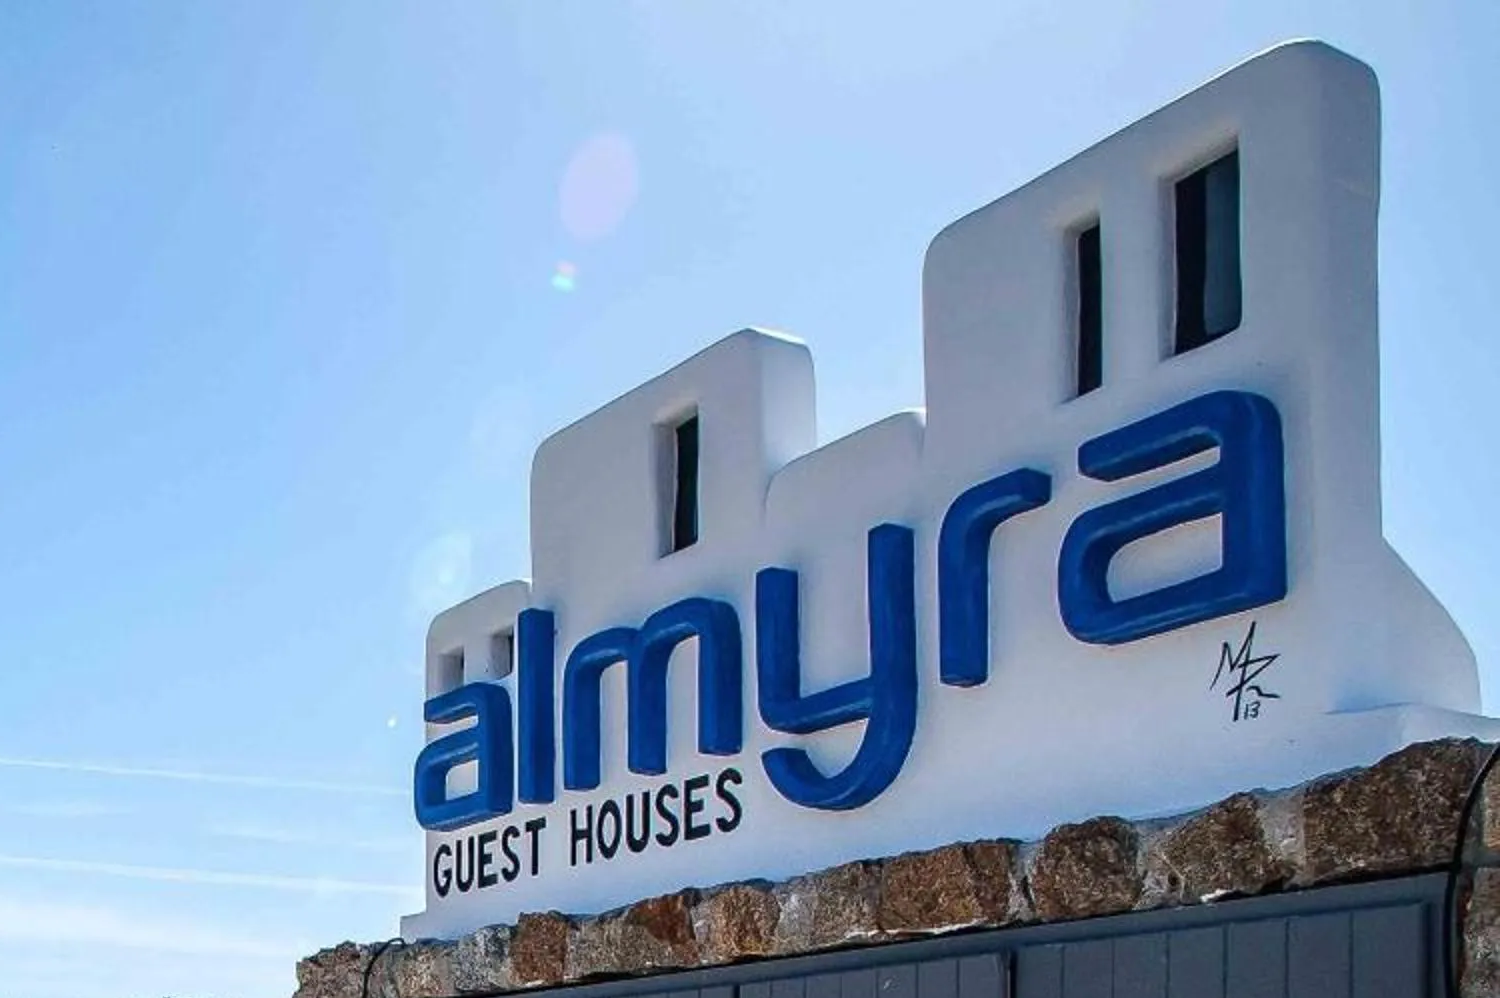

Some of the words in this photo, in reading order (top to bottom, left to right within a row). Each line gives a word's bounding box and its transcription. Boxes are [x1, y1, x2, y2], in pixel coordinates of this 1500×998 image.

[413, 388, 1289, 832] almyra
[433, 816, 546, 898] GUEST
[569, 767, 743, 867] HOUSES
